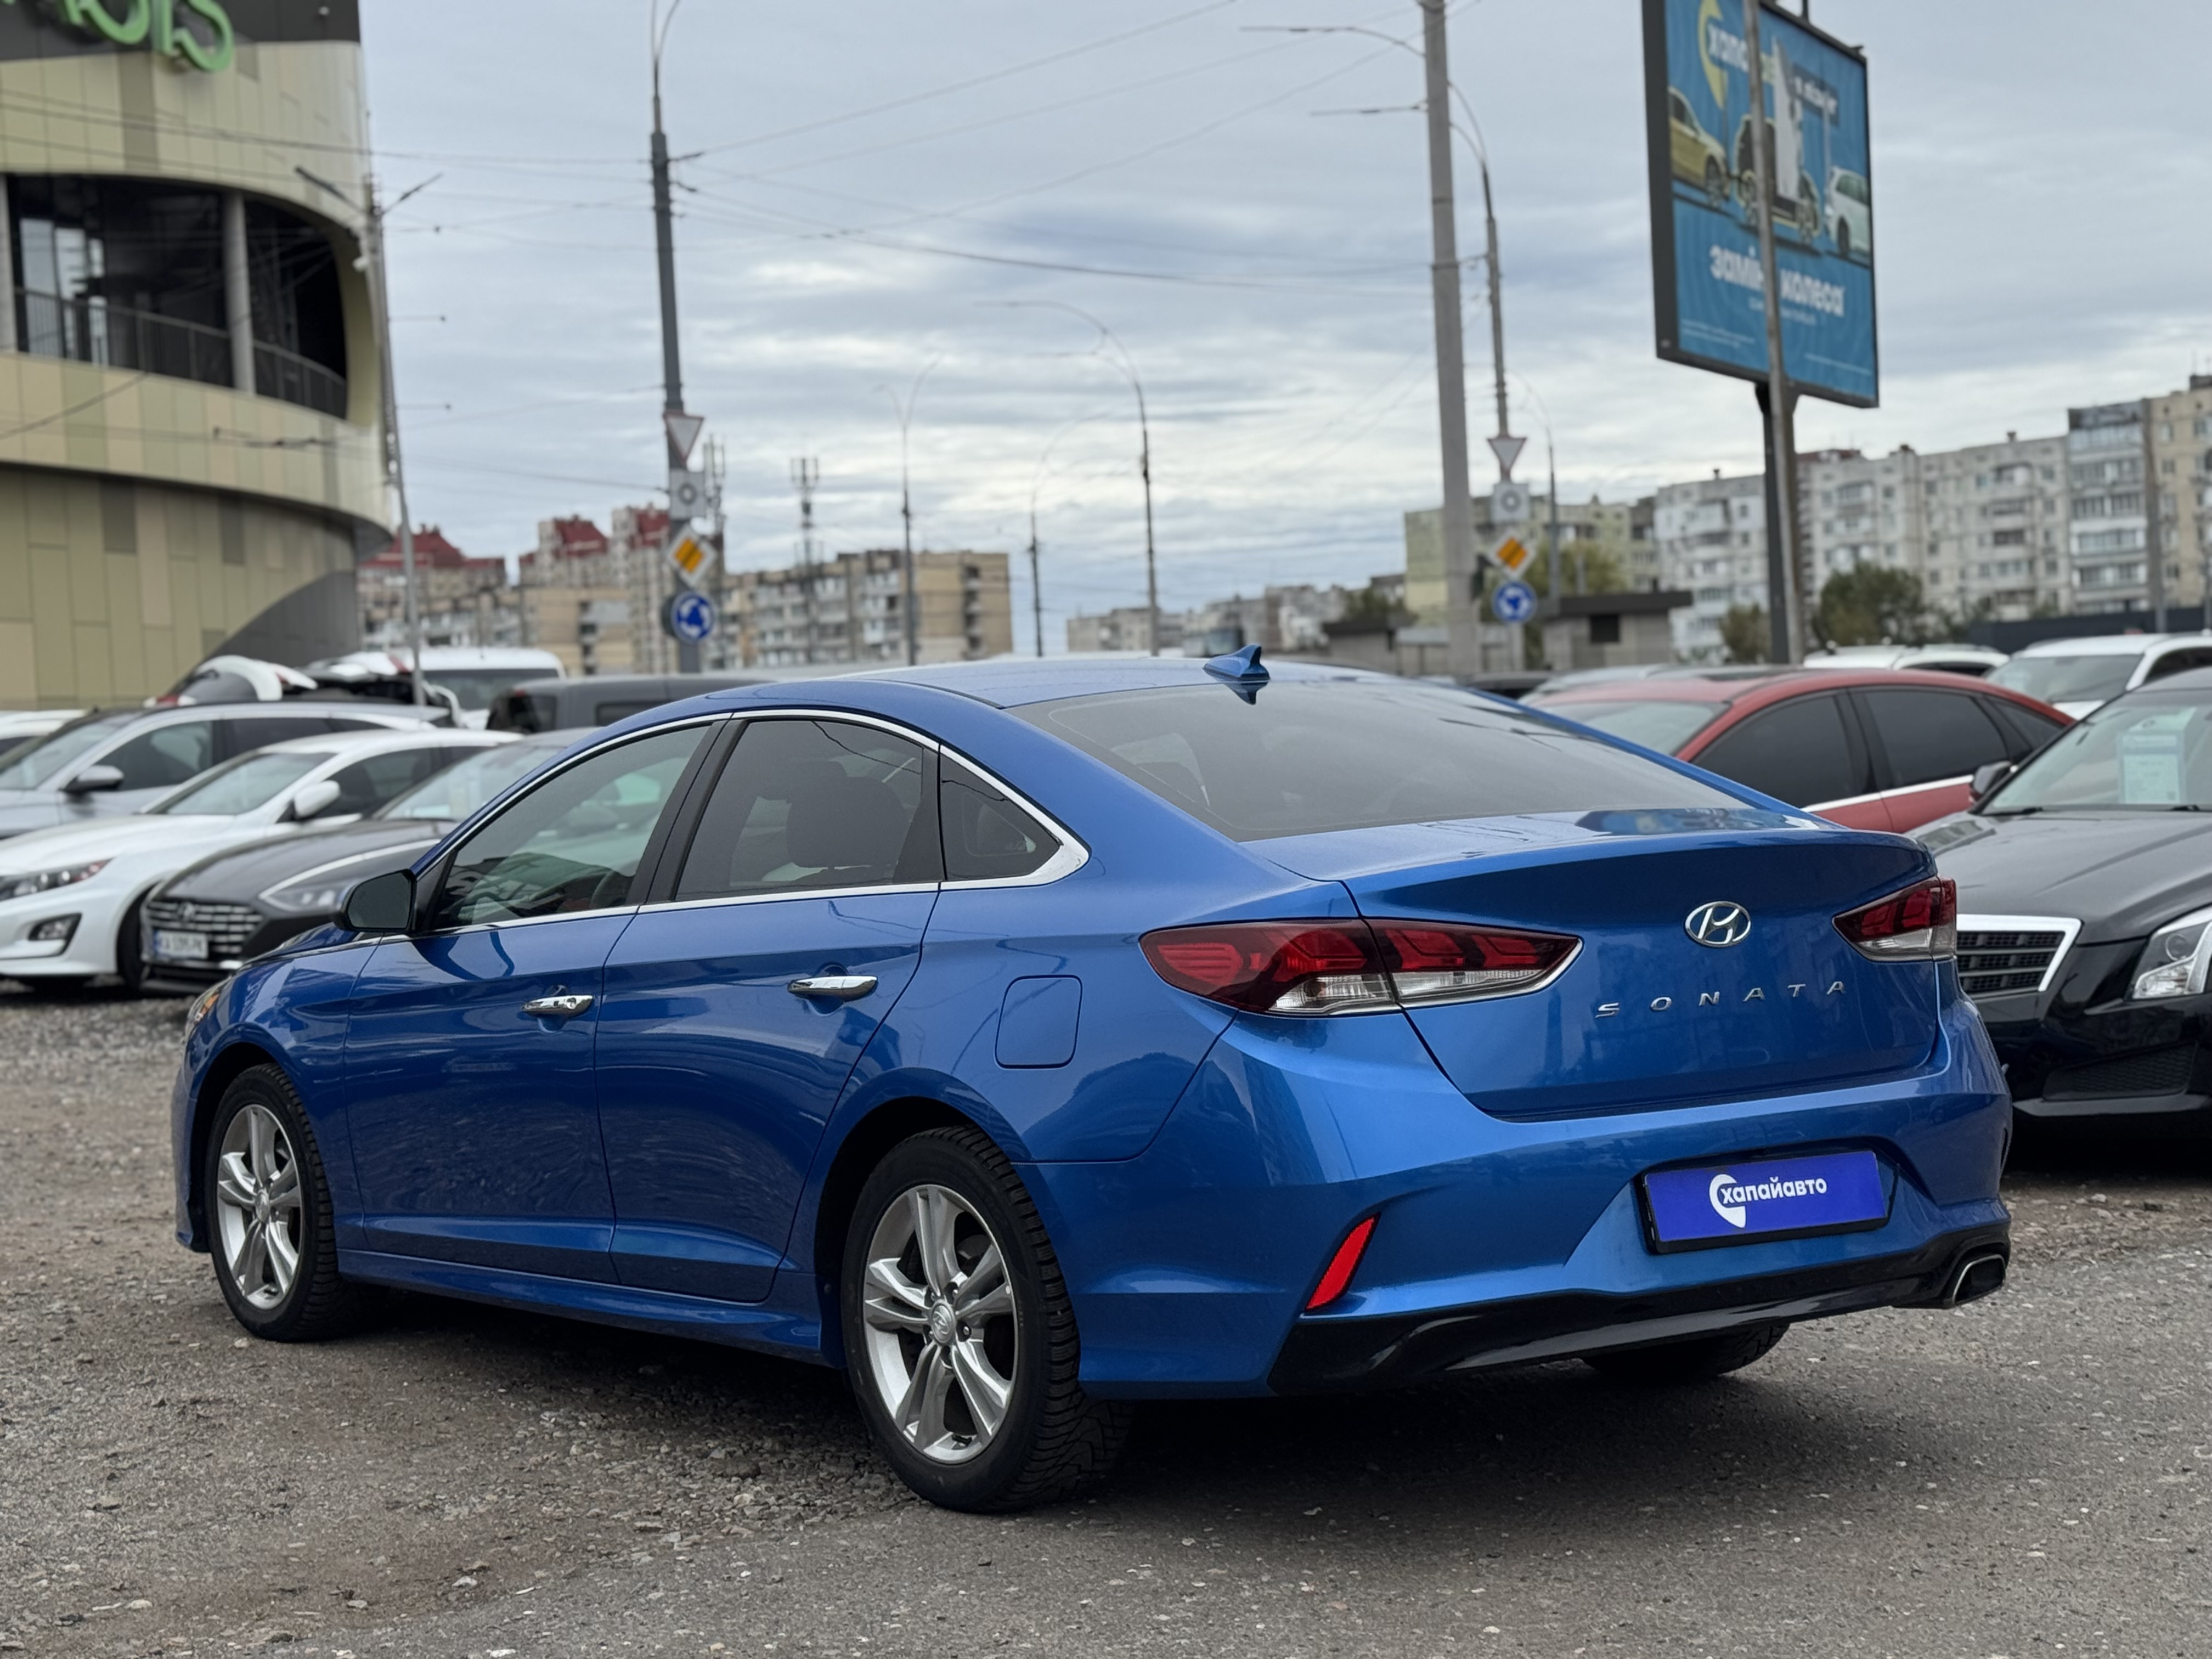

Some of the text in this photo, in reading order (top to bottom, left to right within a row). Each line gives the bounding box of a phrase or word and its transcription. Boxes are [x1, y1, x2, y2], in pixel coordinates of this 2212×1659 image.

[1781, 268, 1845, 317] колеса
[1595, 981, 1846, 1019] SONATA
[1720, 1176, 1827, 1204] хапайавто
